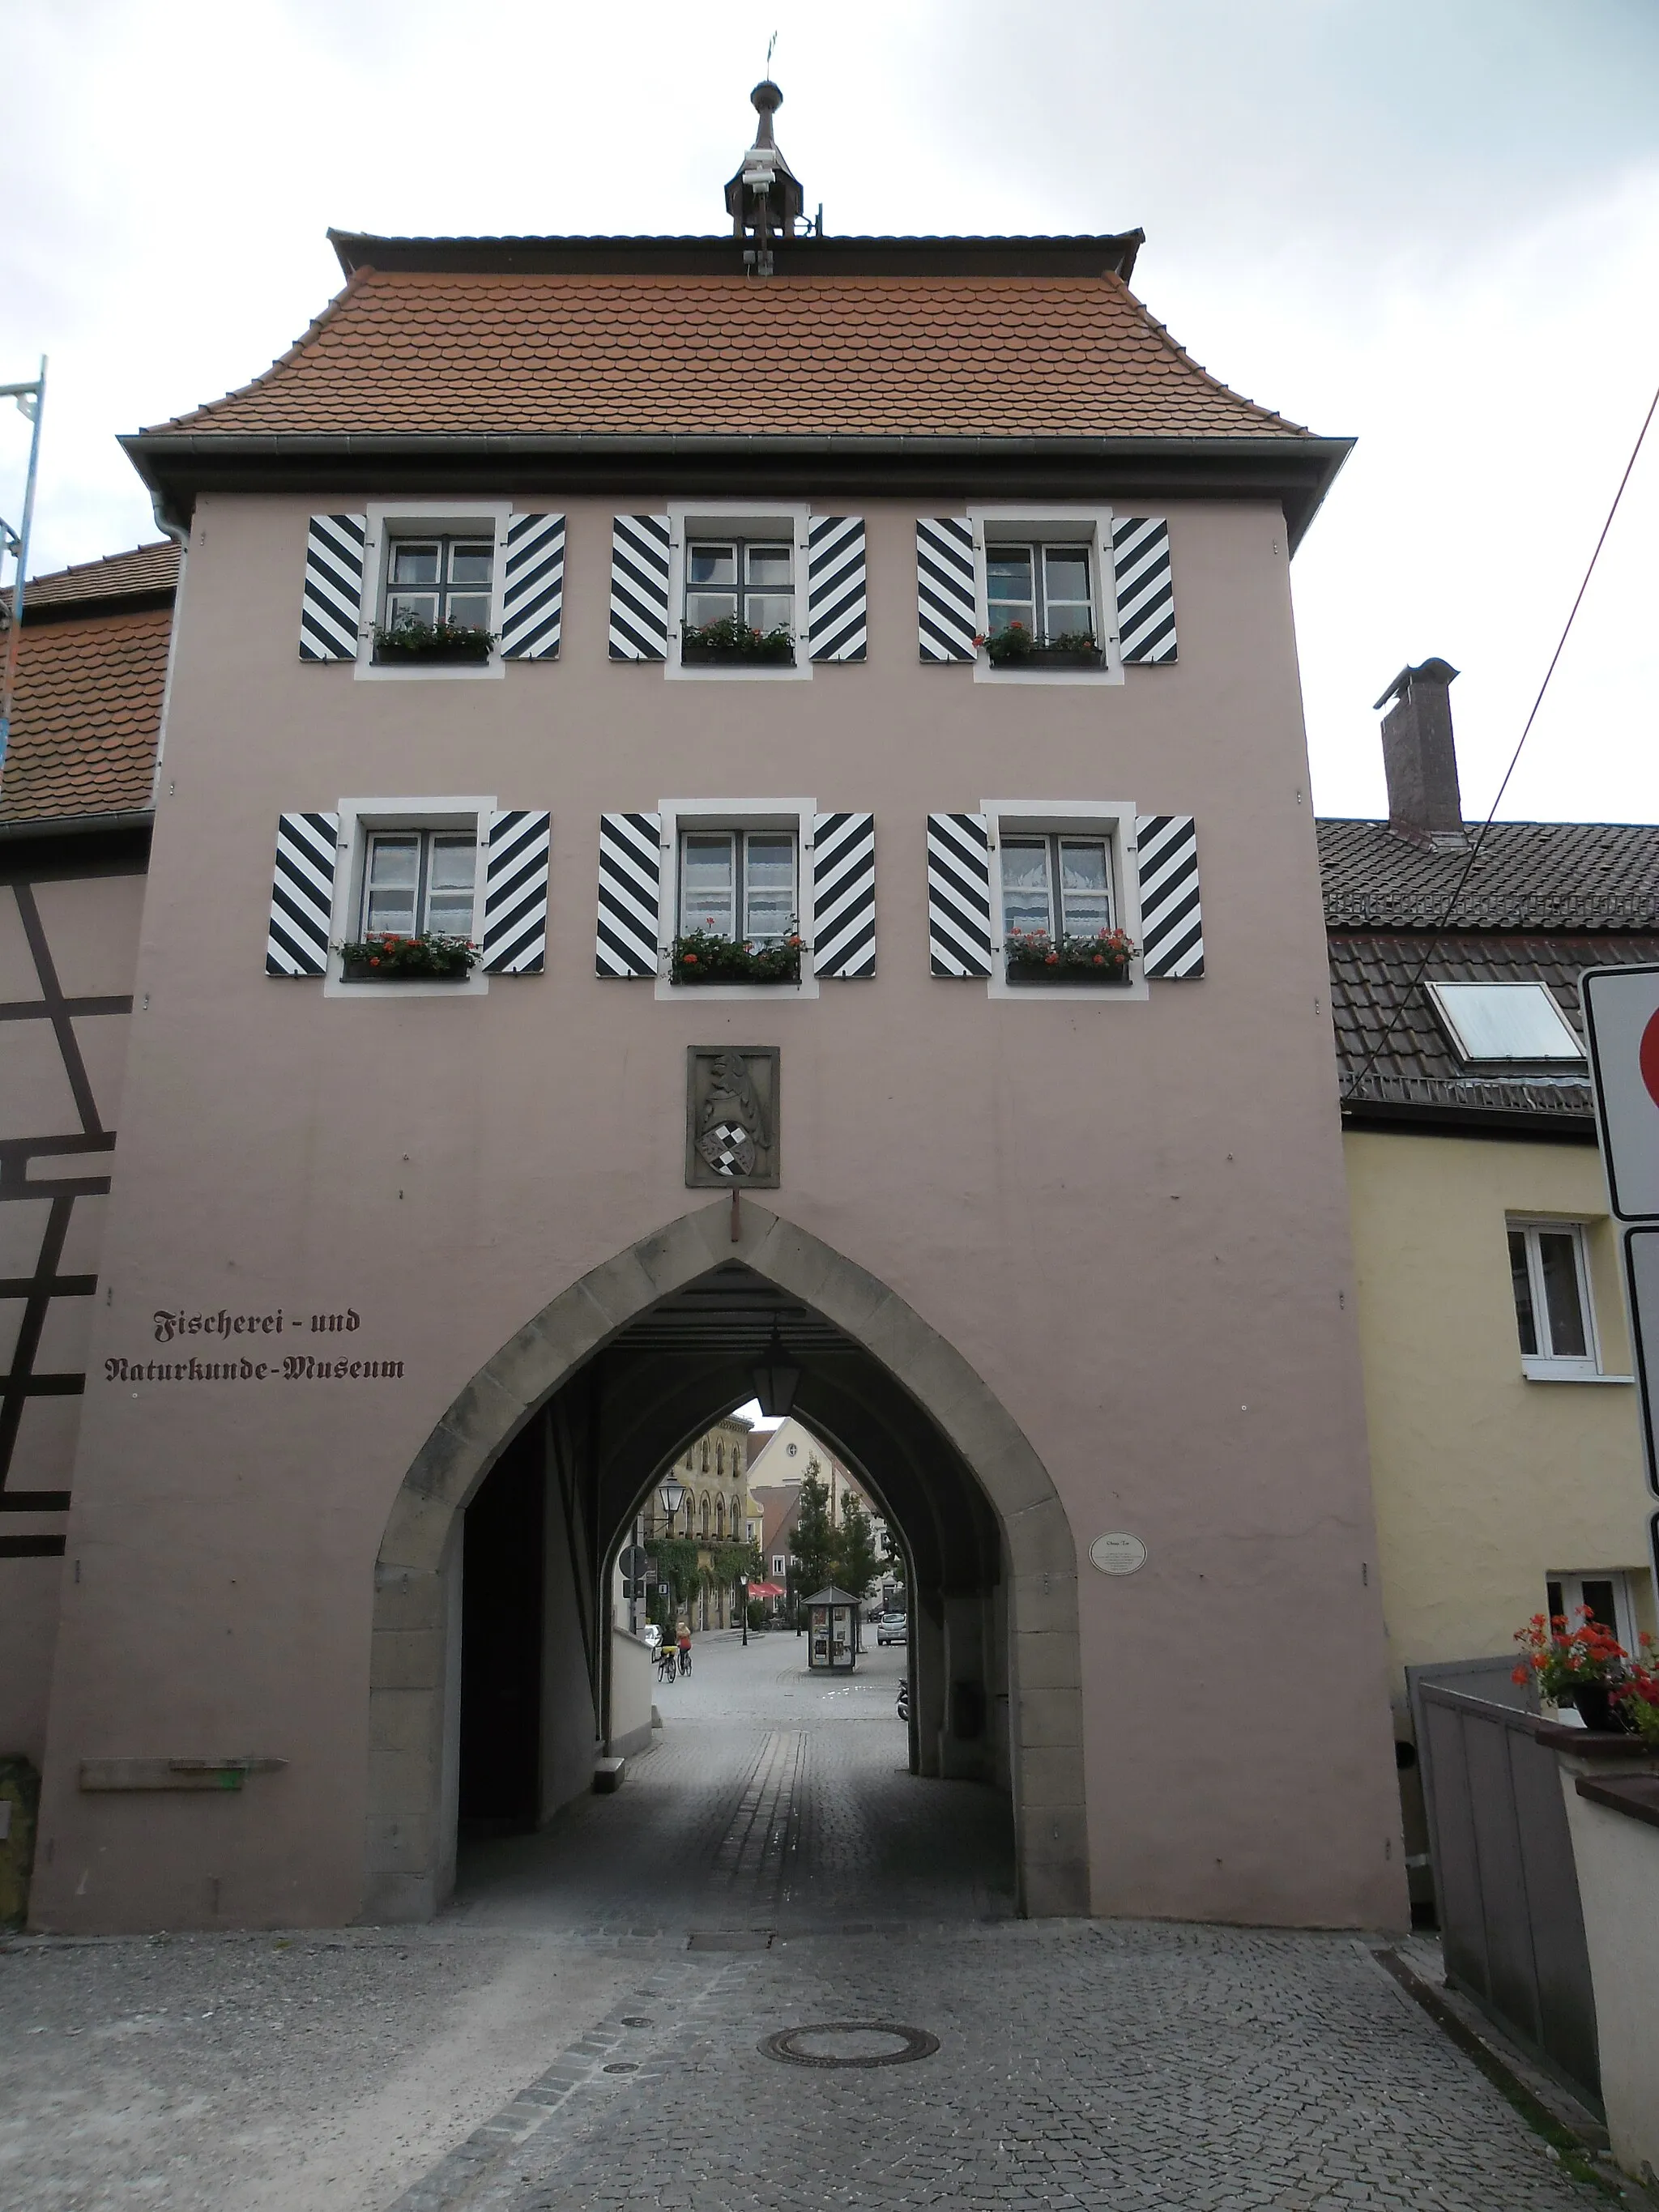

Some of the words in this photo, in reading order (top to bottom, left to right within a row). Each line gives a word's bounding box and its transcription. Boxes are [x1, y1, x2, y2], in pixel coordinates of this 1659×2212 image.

[153, 1308, 284, 1343] Fischerei
[310, 1308, 360, 1333] und
[104, 1356, 405, 1382] Naturkunde-Museum
